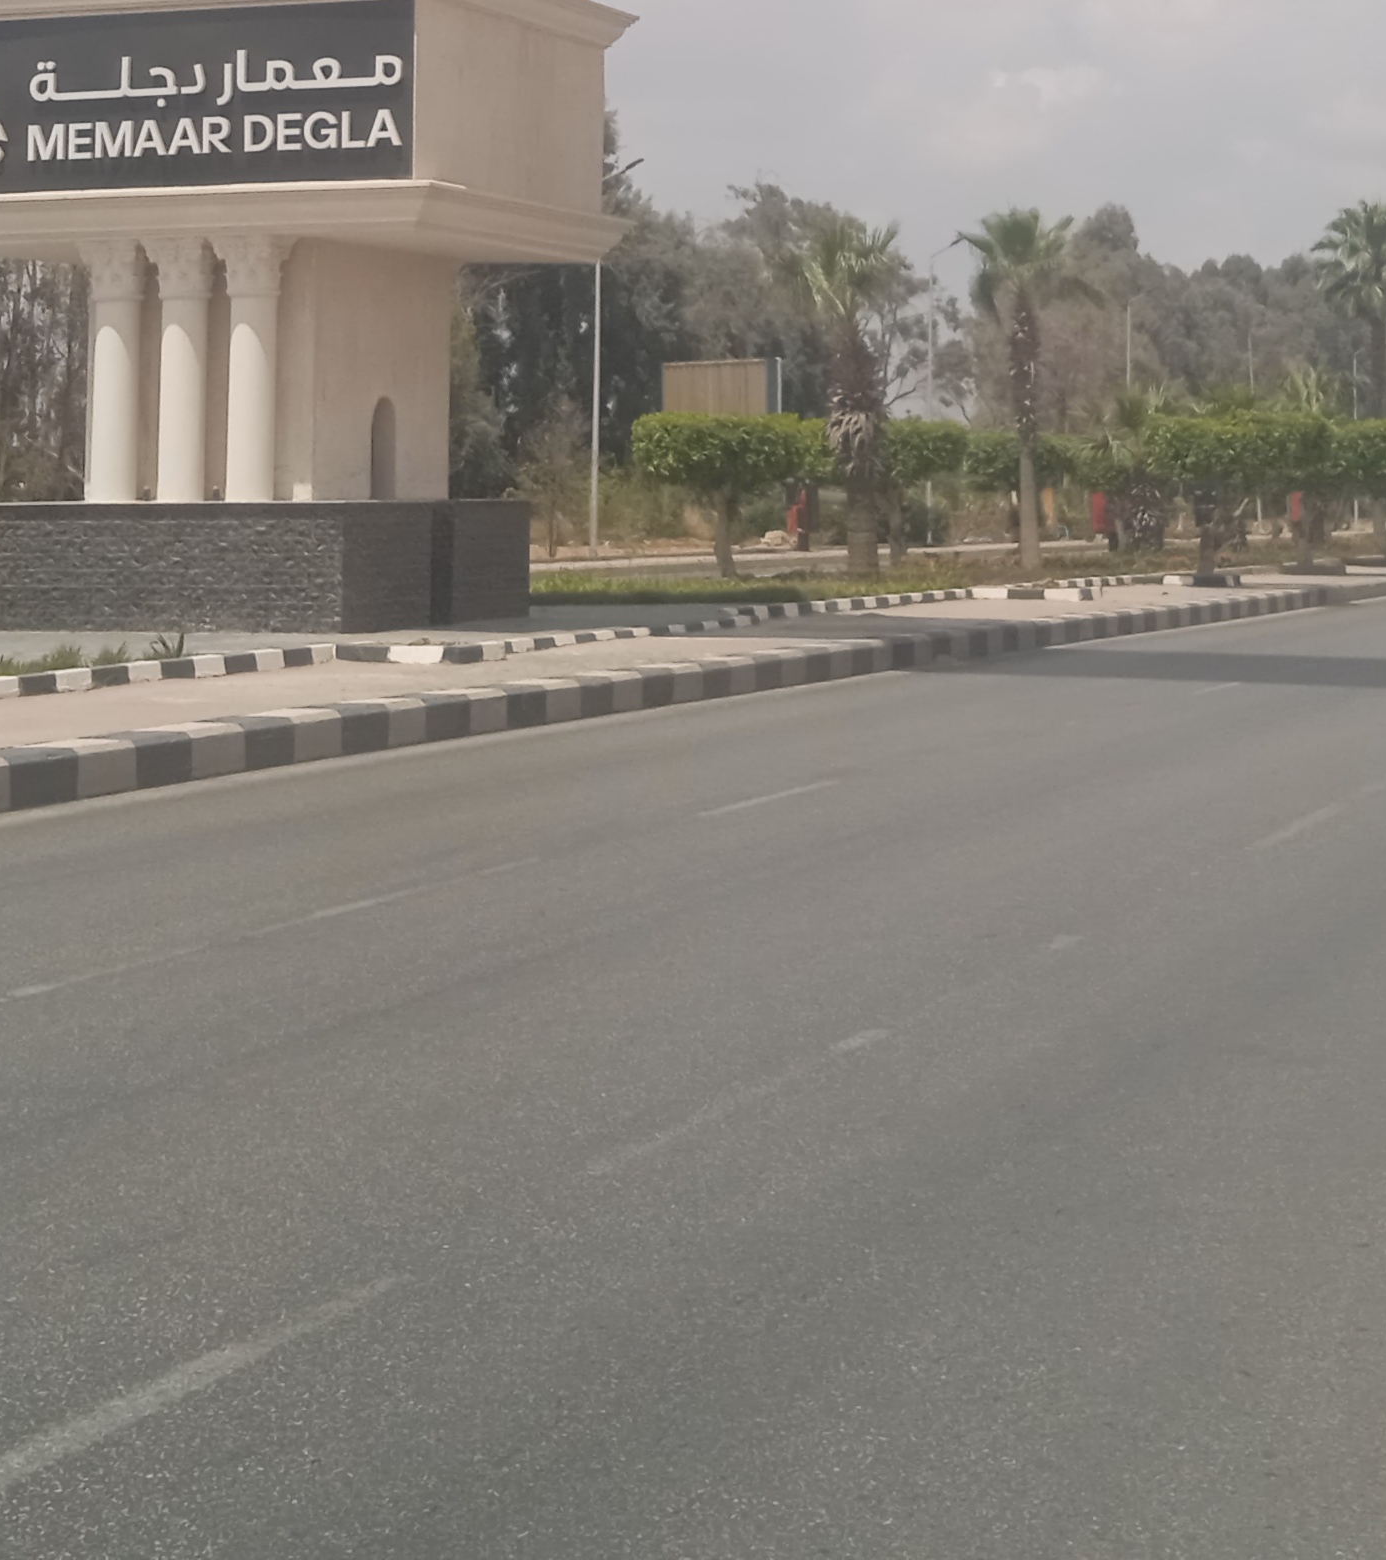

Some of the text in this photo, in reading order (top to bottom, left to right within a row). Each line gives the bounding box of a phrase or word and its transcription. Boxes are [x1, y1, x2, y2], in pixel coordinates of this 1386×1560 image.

[29, 49, 404, 108] معمار دجلة
[26, 109, 403, 162] MEMAAR DEGLA
